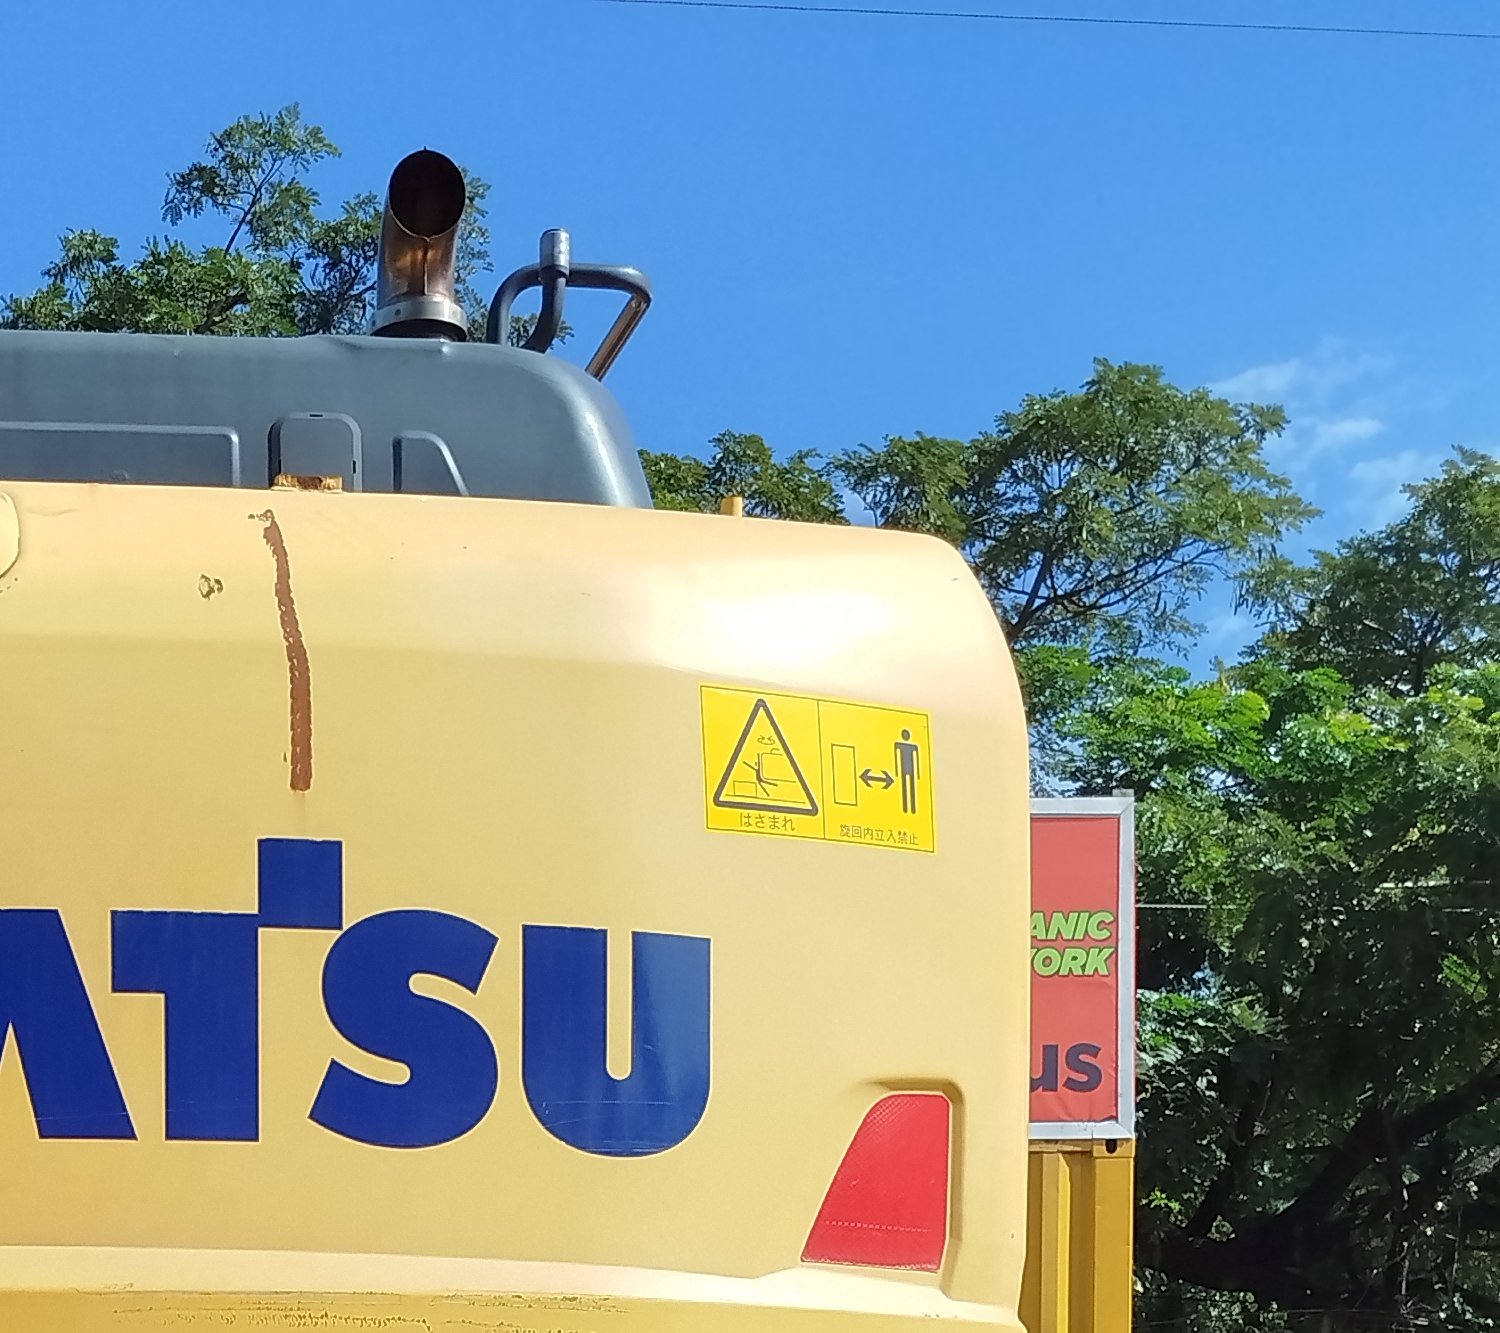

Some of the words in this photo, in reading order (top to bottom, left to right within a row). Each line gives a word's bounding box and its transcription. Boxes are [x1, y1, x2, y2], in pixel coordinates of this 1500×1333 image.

[739, 812, 796, 832] はさまれ
[839, 823, 920, 846] 旋回内立入禁止
[1031, 946, 1115, 977] ORK
